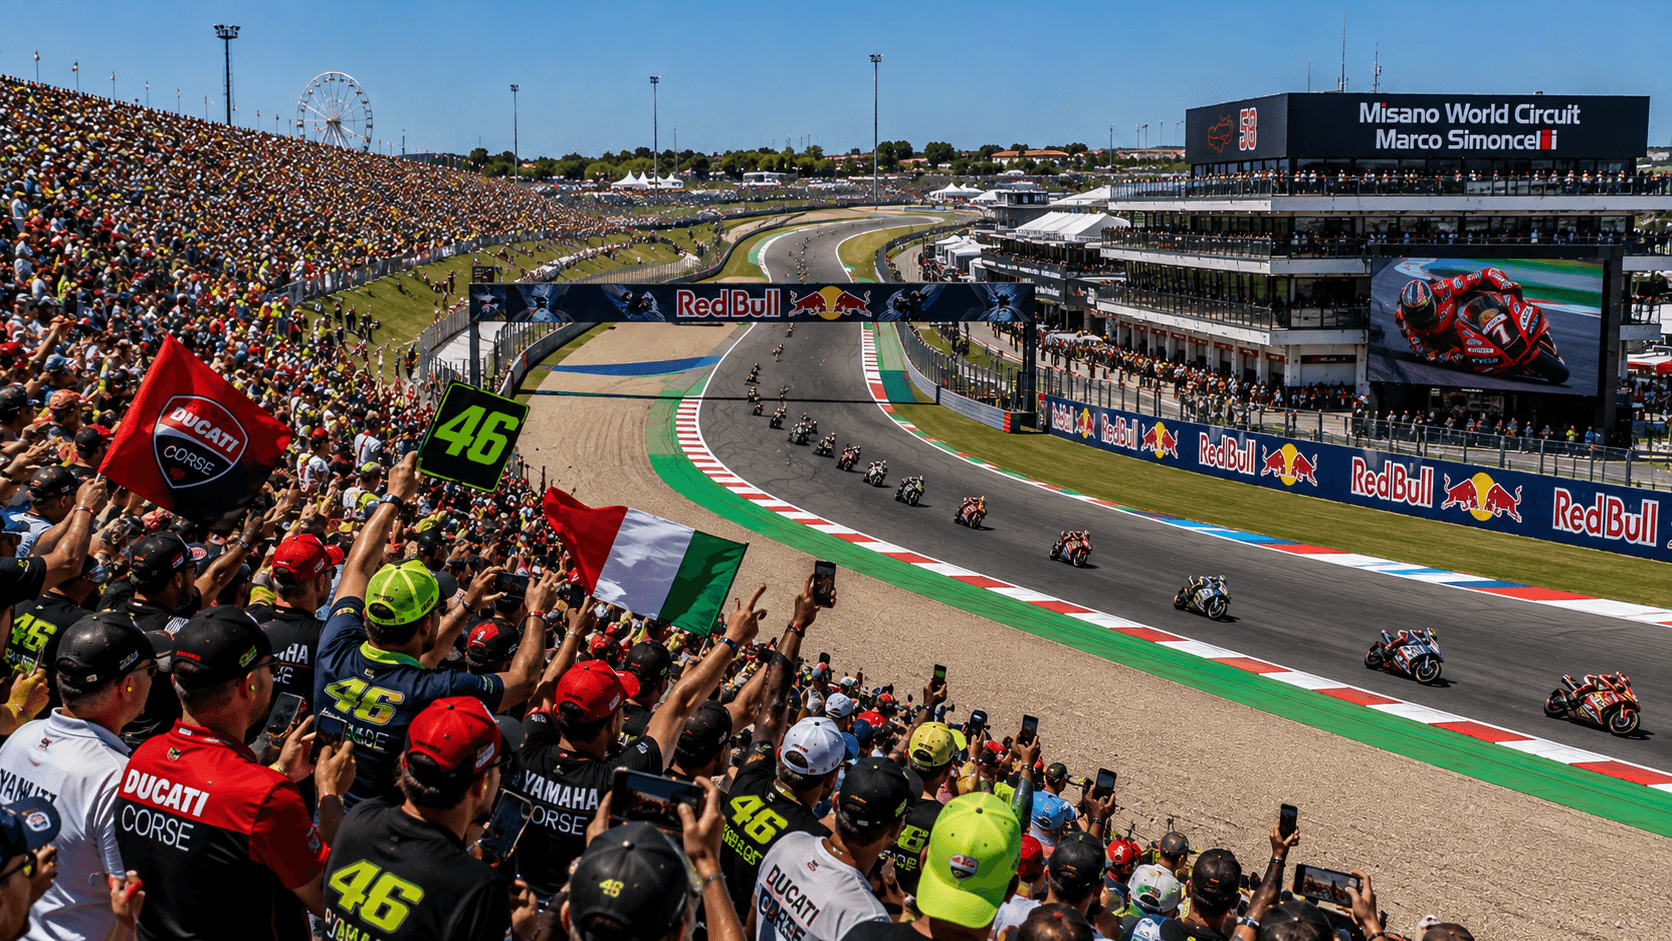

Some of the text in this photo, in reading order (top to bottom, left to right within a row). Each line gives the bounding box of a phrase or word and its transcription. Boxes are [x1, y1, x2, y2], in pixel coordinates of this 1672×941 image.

[1239, 107, 1257, 151] 58
[1359, 102, 1581, 125] Misano World Circuit
[1375, 129, 1442, 149] Marco
[677, 288, 780, 318] Red Bull
[169, 406, 240, 453] DUCATI
[433, 404, 520, 466] 46
[1101, 413, 1139, 451] Red Bull
[164, 445, 215, 476] CORSE
[1199, 432, 1256, 475] Red Bull
[1351, 456, 1434, 508] Red Bull
[1552, 487, 1659, 547] Red Bull
[323, 676, 405, 726] 46
[123, 768, 210, 818] DUCATI
[522, 769, 599, 811] YAMAHA
[121, 804, 194, 851] CORSE
[729, 795, 788, 845] 46
[328, 859, 425, 934] 46
[599, 879, 624, 898] 46
[766, 864, 820, 928] DUCATI
